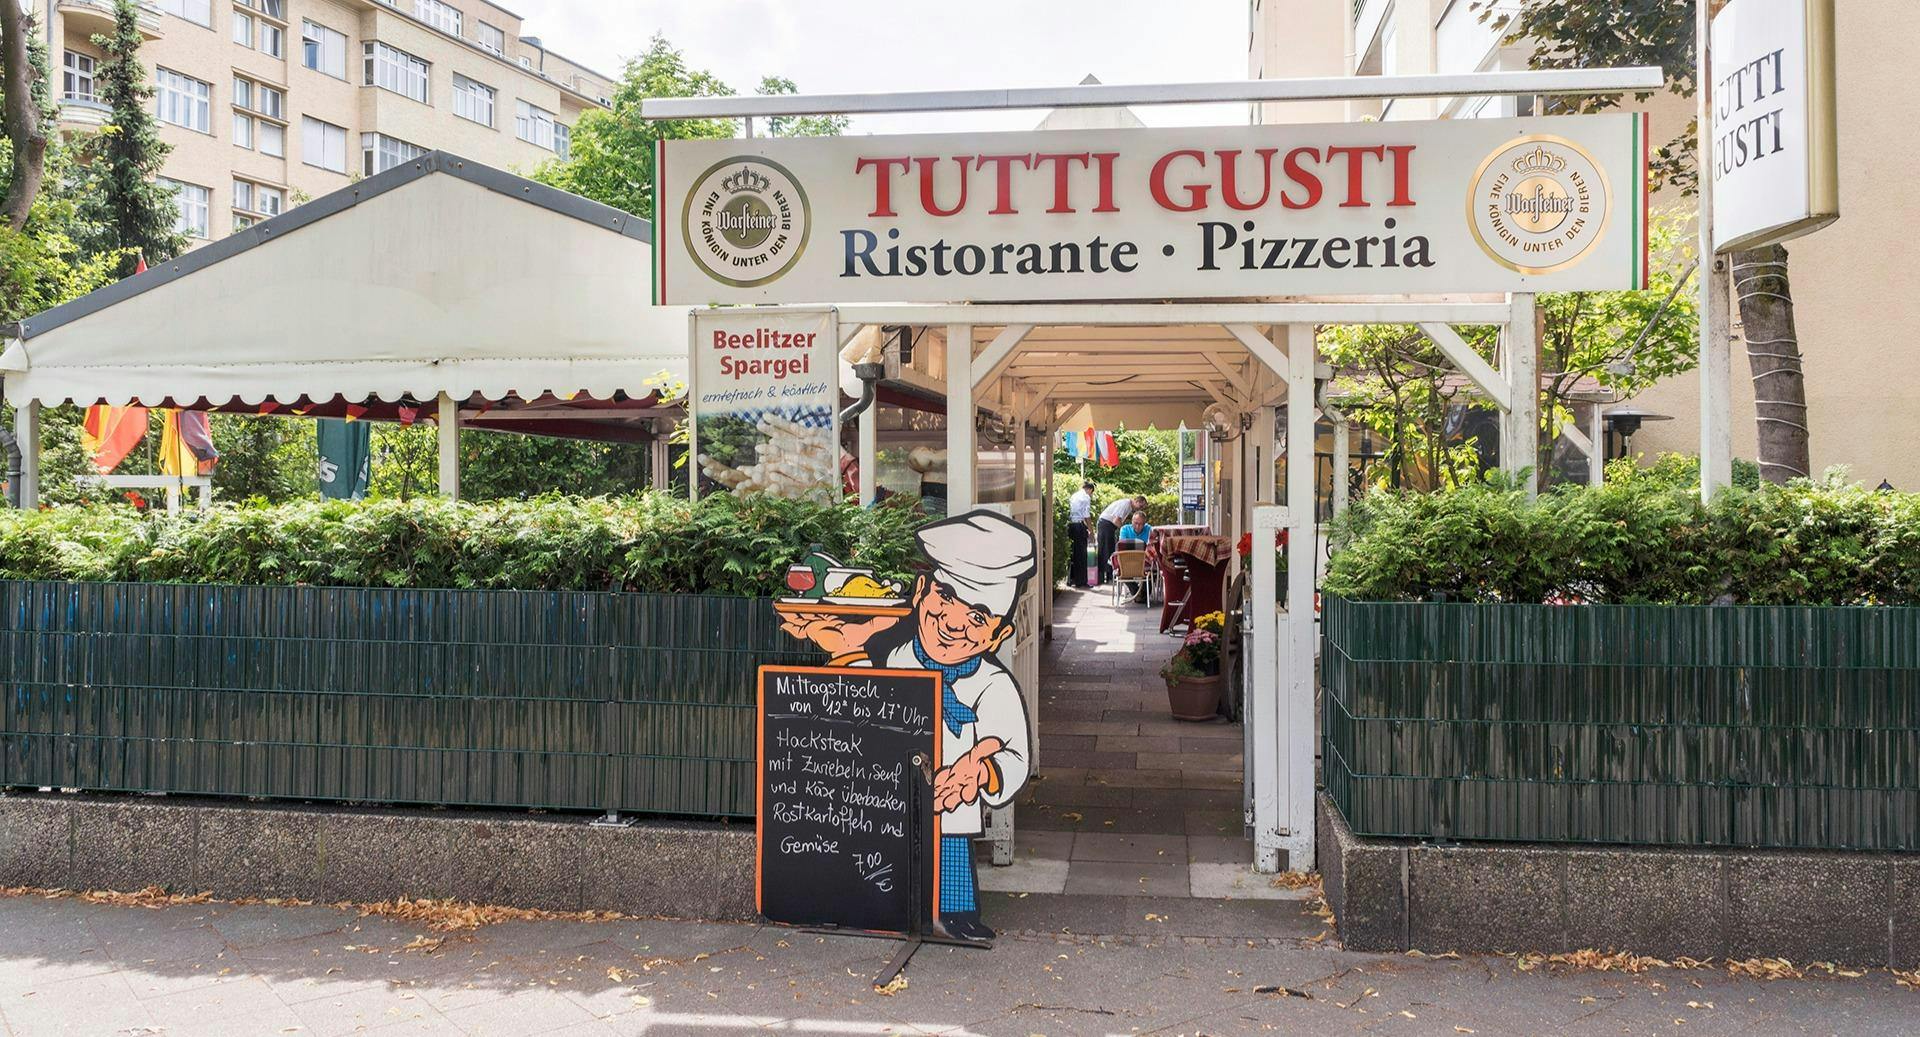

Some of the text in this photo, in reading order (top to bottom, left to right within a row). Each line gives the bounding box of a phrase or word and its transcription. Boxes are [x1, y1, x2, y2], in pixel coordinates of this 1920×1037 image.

[1714, 108, 1785, 181] GUSTI
[855, 144, 1417, 217] TUTTI GUSTI
[1488, 171, 1589, 252] EINE KÖNIGIN UNTER DEN BIEREN
[701, 190, 791, 267] EINE KÖNIGIN UNTER DEN BIEREN
[839, 218, 1436, 278] Ristorante Pizzeria
[713, 328, 817, 349] Beelitzer
[720, 353, 809, 380] Spargel
[702, 381, 827, 404] erntefrisch & köstlich
[790, 701, 812, 714] von
[853, 702, 871, 718] bis
[902, 706, 929, 726] Uhr
[776, 727, 863, 757] Hacksteak
[769, 751, 793, 772] mit
[872, 762, 902, 791] Senf
[771, 781, 797, 795] und
[881, 821, 905, 838] und
[780, 834, 840, 854] Gemüse
[875, 878, 893, 893] €
